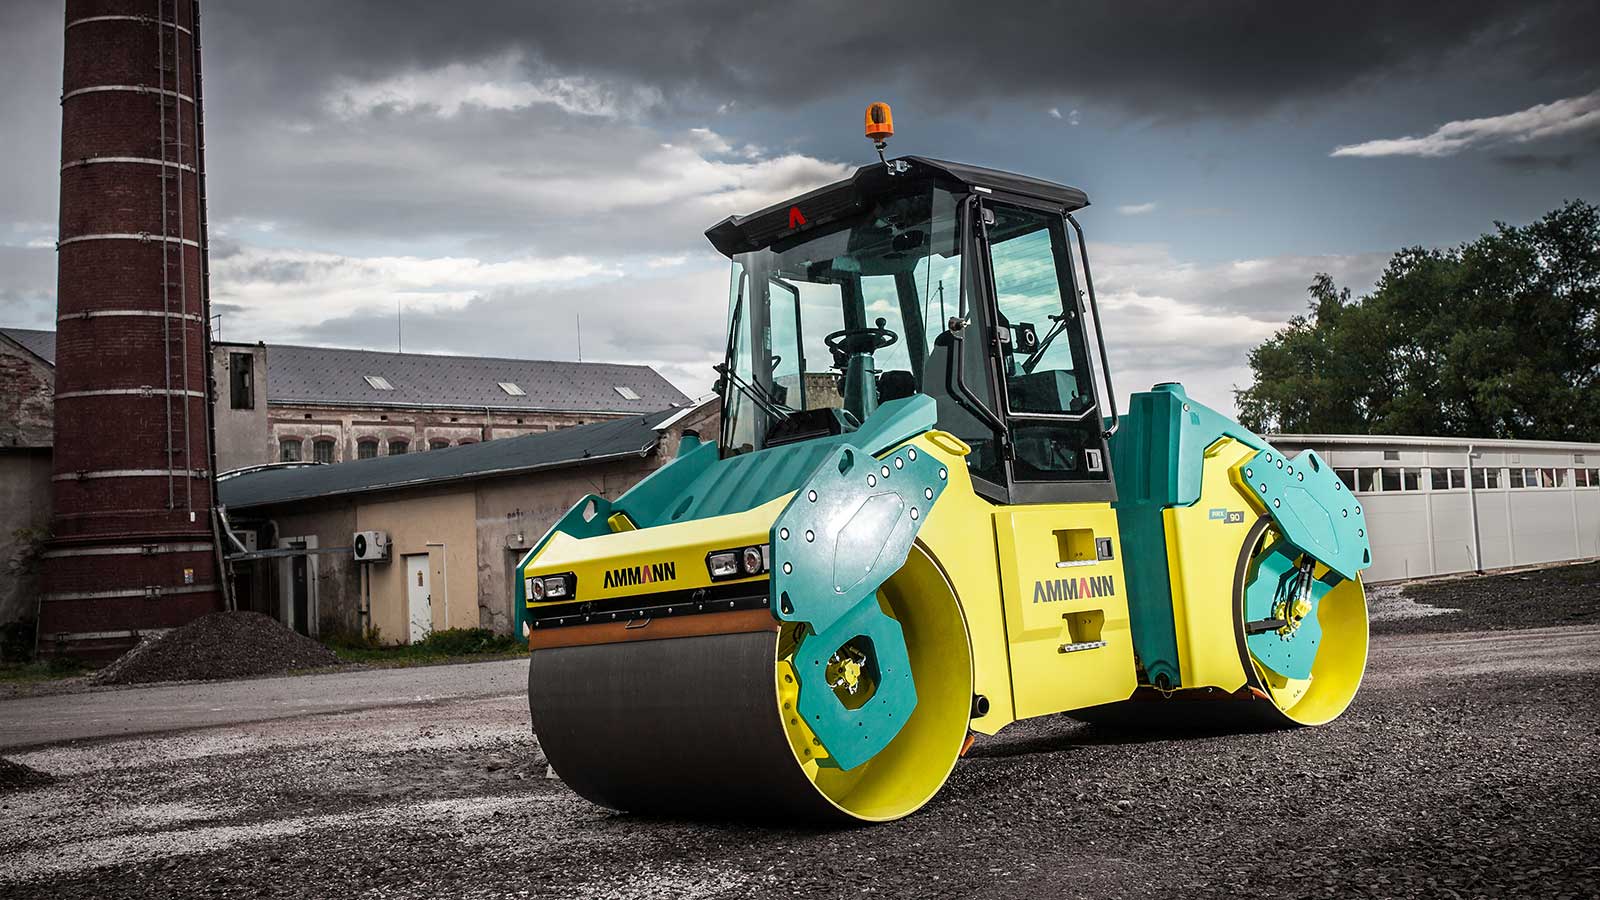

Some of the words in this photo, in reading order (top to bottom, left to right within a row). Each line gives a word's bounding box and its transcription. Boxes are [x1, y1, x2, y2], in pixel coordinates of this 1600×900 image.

[1229, 513, 1240, 521] 90
[603, 561, 676, 589] AMMANN
[1033, 575, 1115, 603] AMMANN
